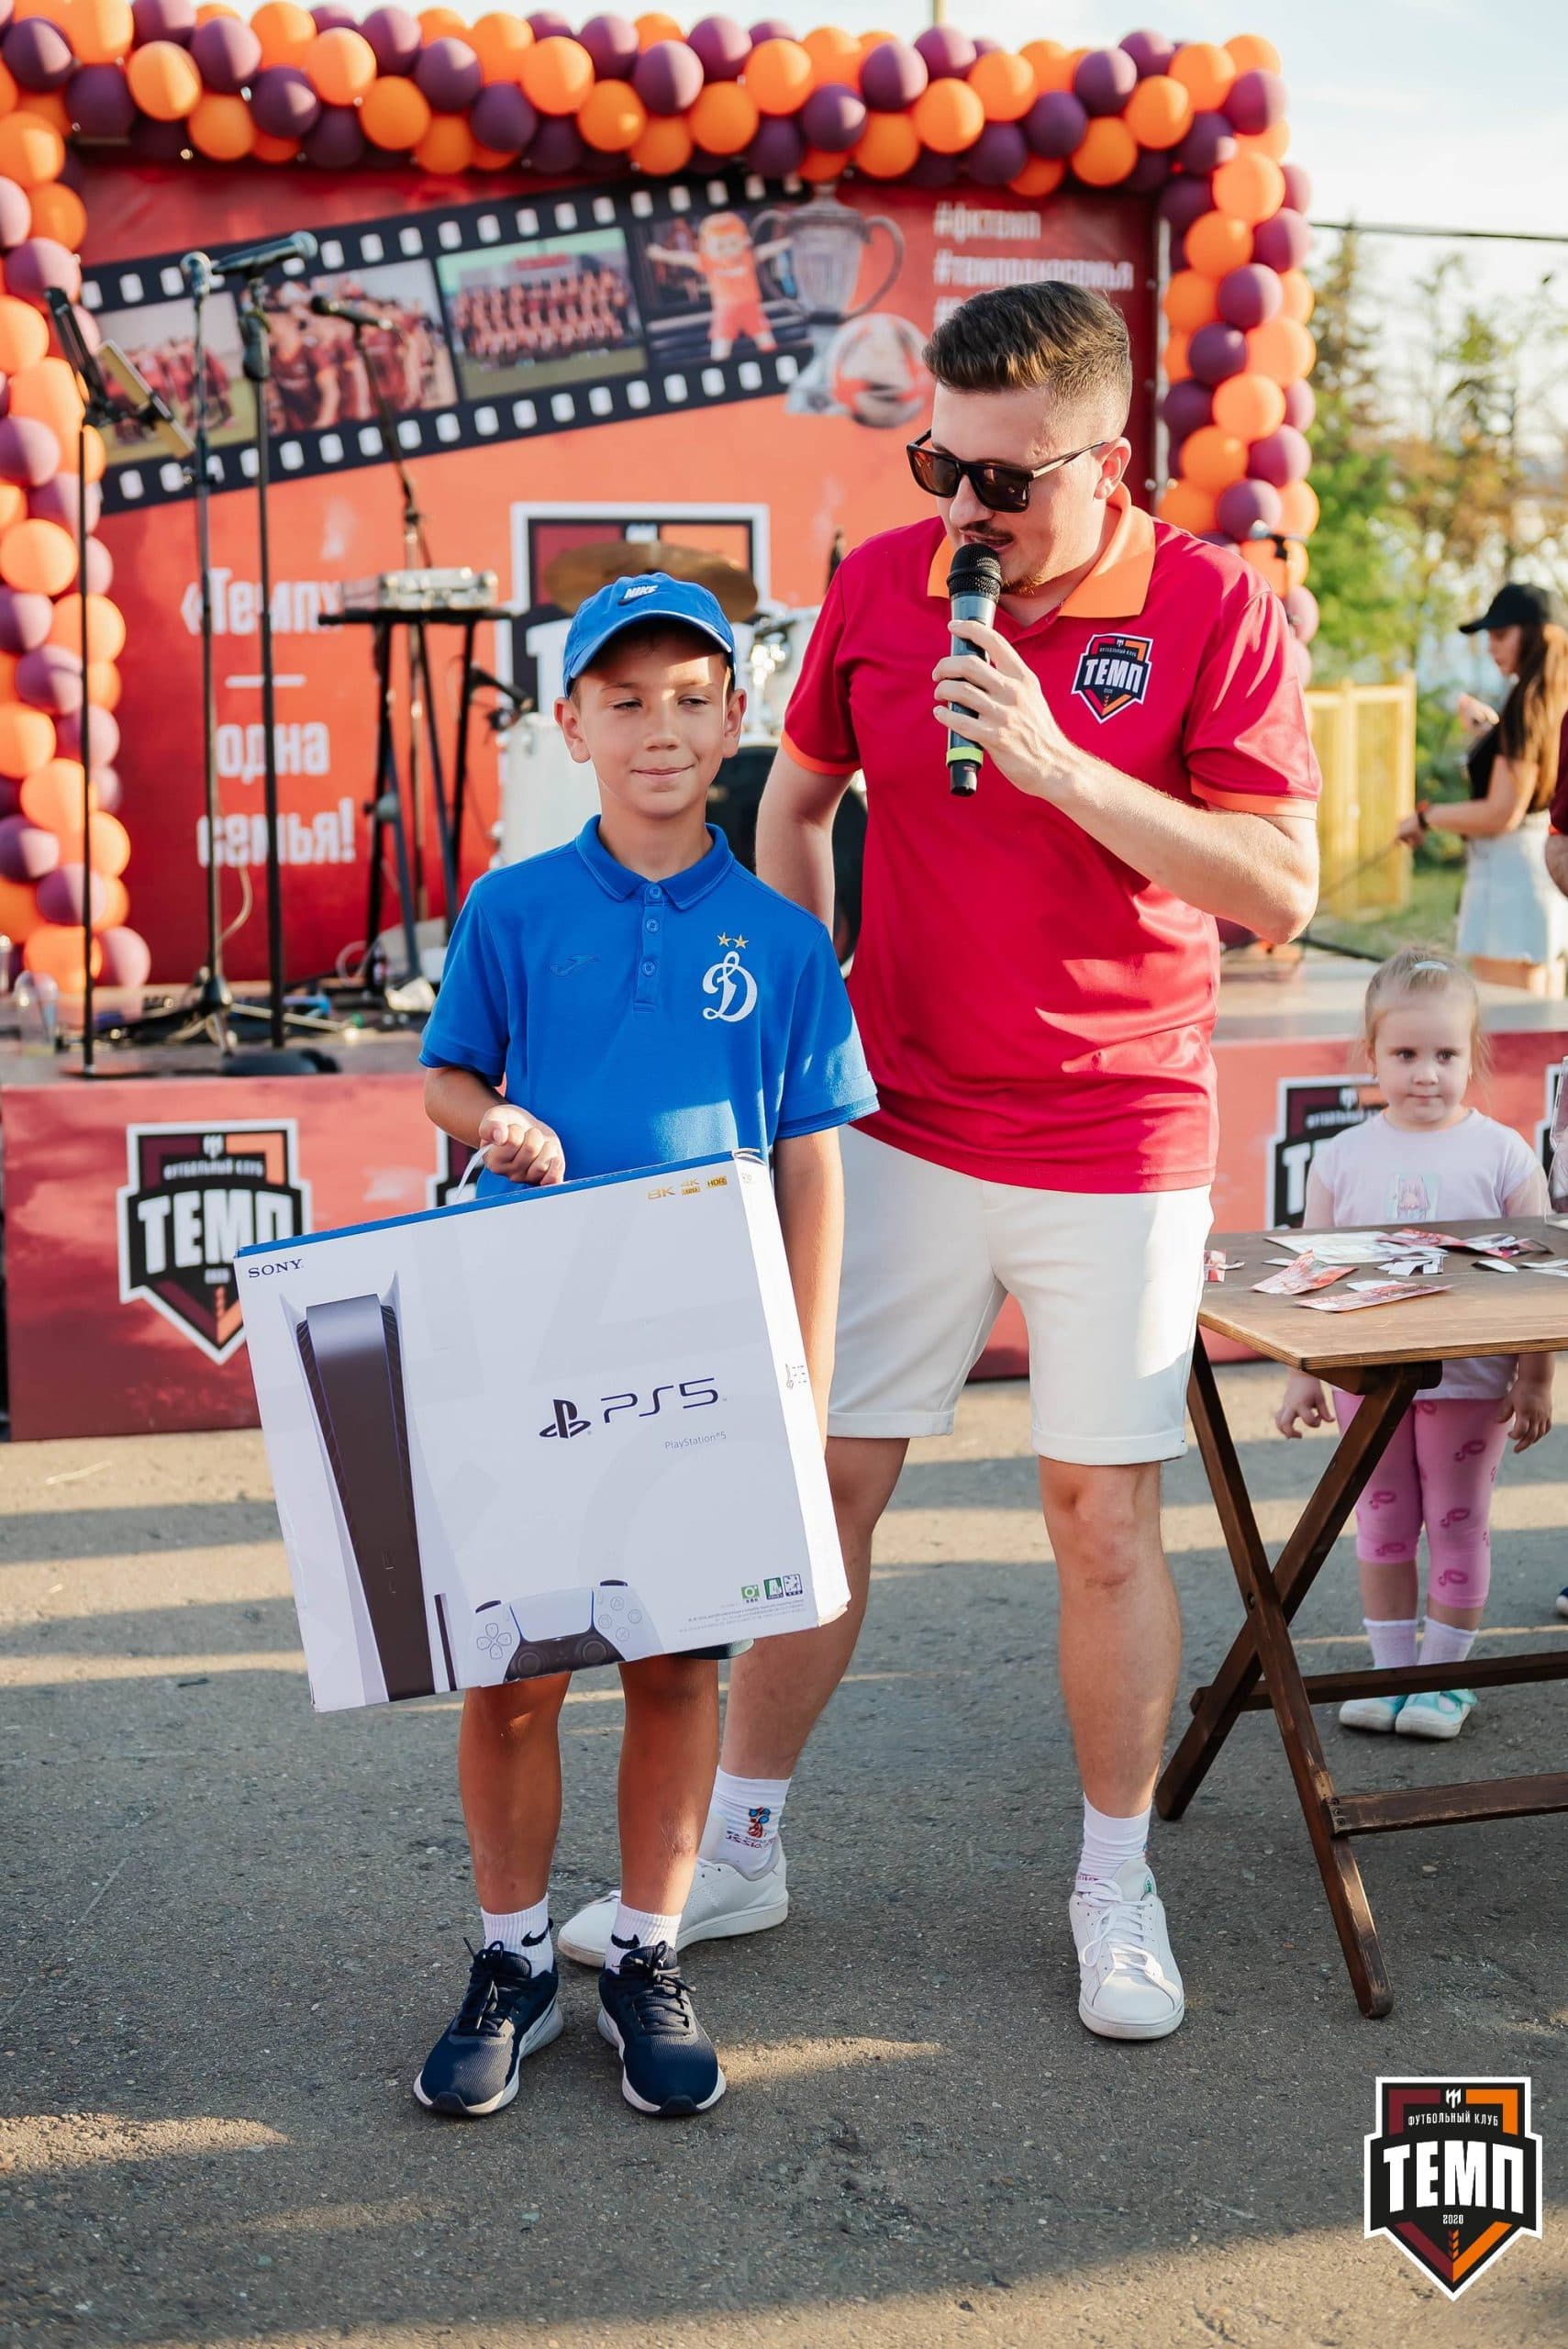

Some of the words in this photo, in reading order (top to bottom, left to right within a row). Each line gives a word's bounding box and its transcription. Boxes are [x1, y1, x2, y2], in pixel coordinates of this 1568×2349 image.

[623, 584, 659, 599] NIKE
[1083, 659, 1144, 694] ТЕМП
[248, 1258, 303, 1278] SONY
[600, 1377, 718, 1424] PS5
